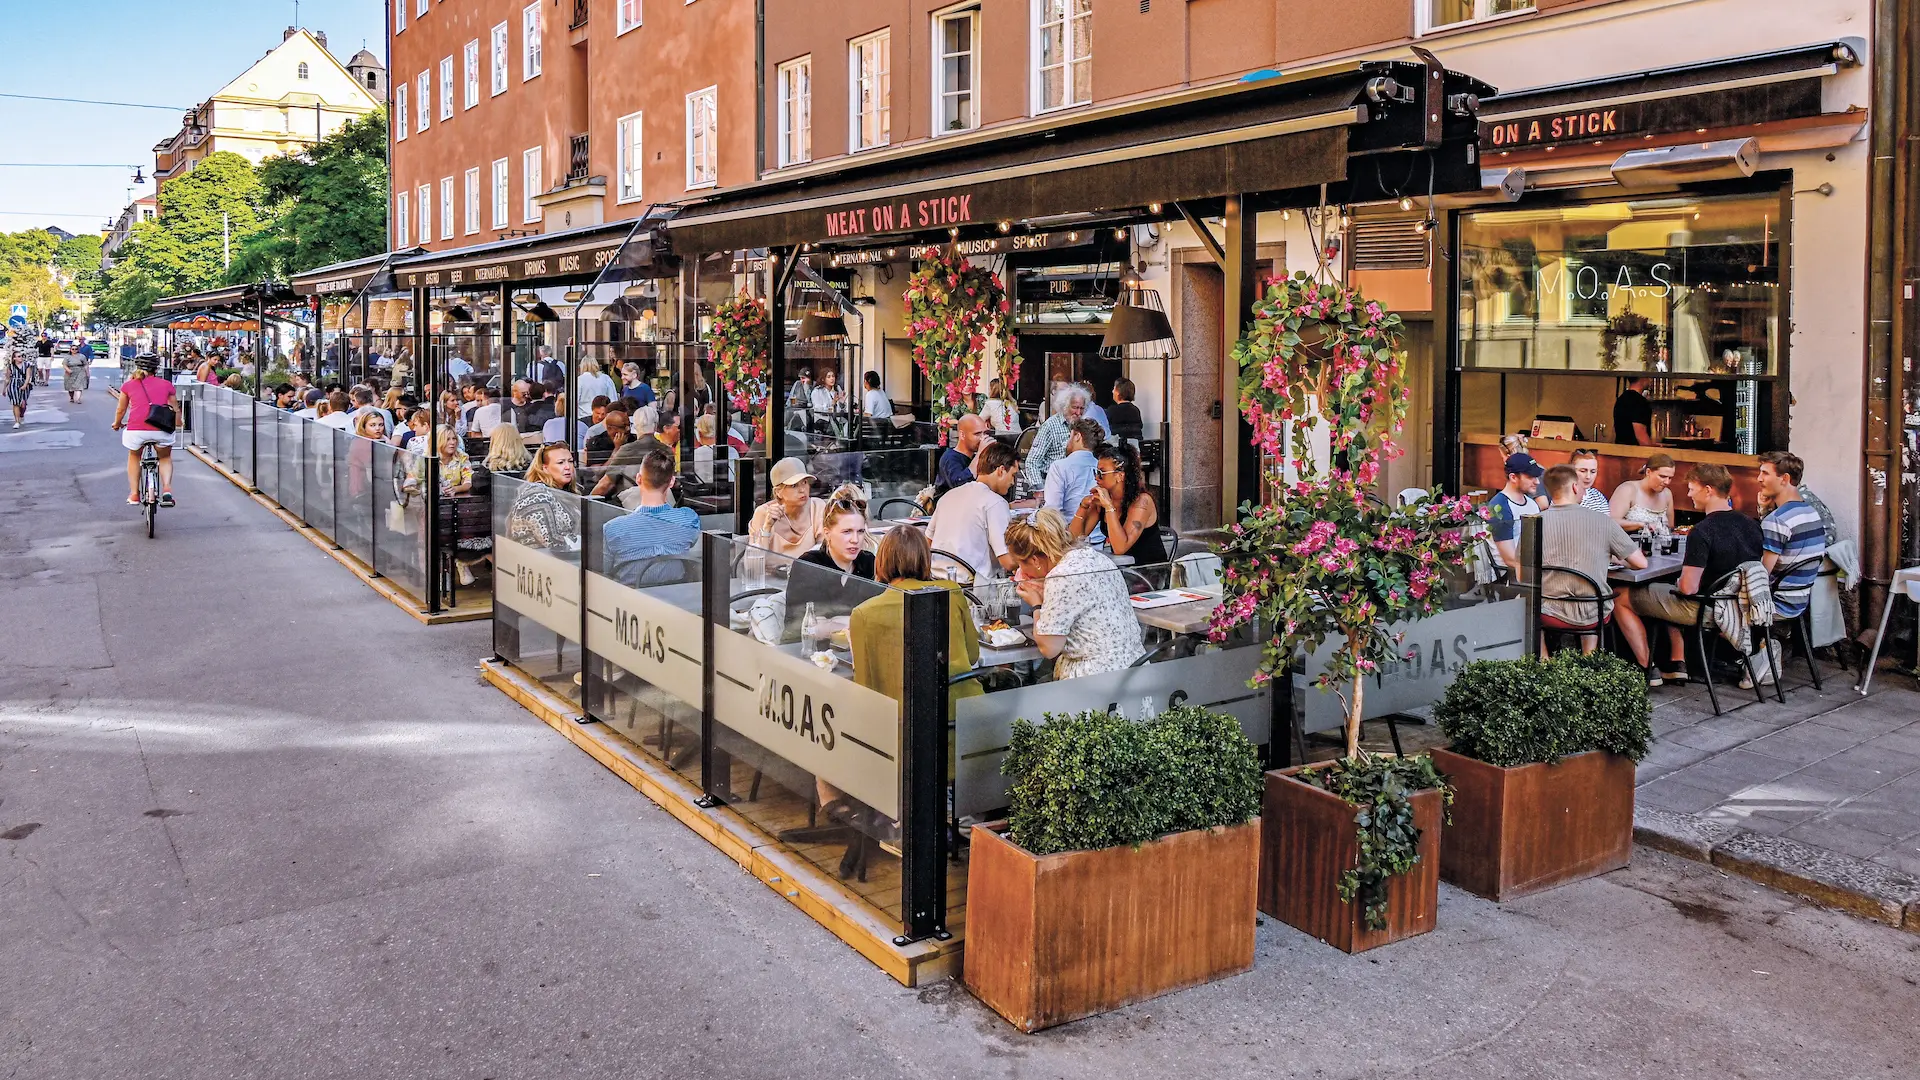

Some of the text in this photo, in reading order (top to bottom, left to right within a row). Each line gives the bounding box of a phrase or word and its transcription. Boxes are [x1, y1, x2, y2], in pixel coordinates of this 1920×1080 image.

[1492, 110, 1617, 145] ON A STICK
[826, 194, 971, 237] MEAT ON A STICK
[961, 239, 990, 255] MUSIC
[408, 274, 416, 285] PUB
[425, 272, 439, 285] BISTRO
[451, 270, 462, 283] BEER
[524, 259, 546, 276] DRINKS
[559, 254, 580, 272] MUSIC
[1050, 280, 1068, 293] PUB
[516, 563, 553, 608] M.O.A.S
[615, 607, 665, 664] M.O.A.S
[758, 672, 835, 751] M.O.A.S
